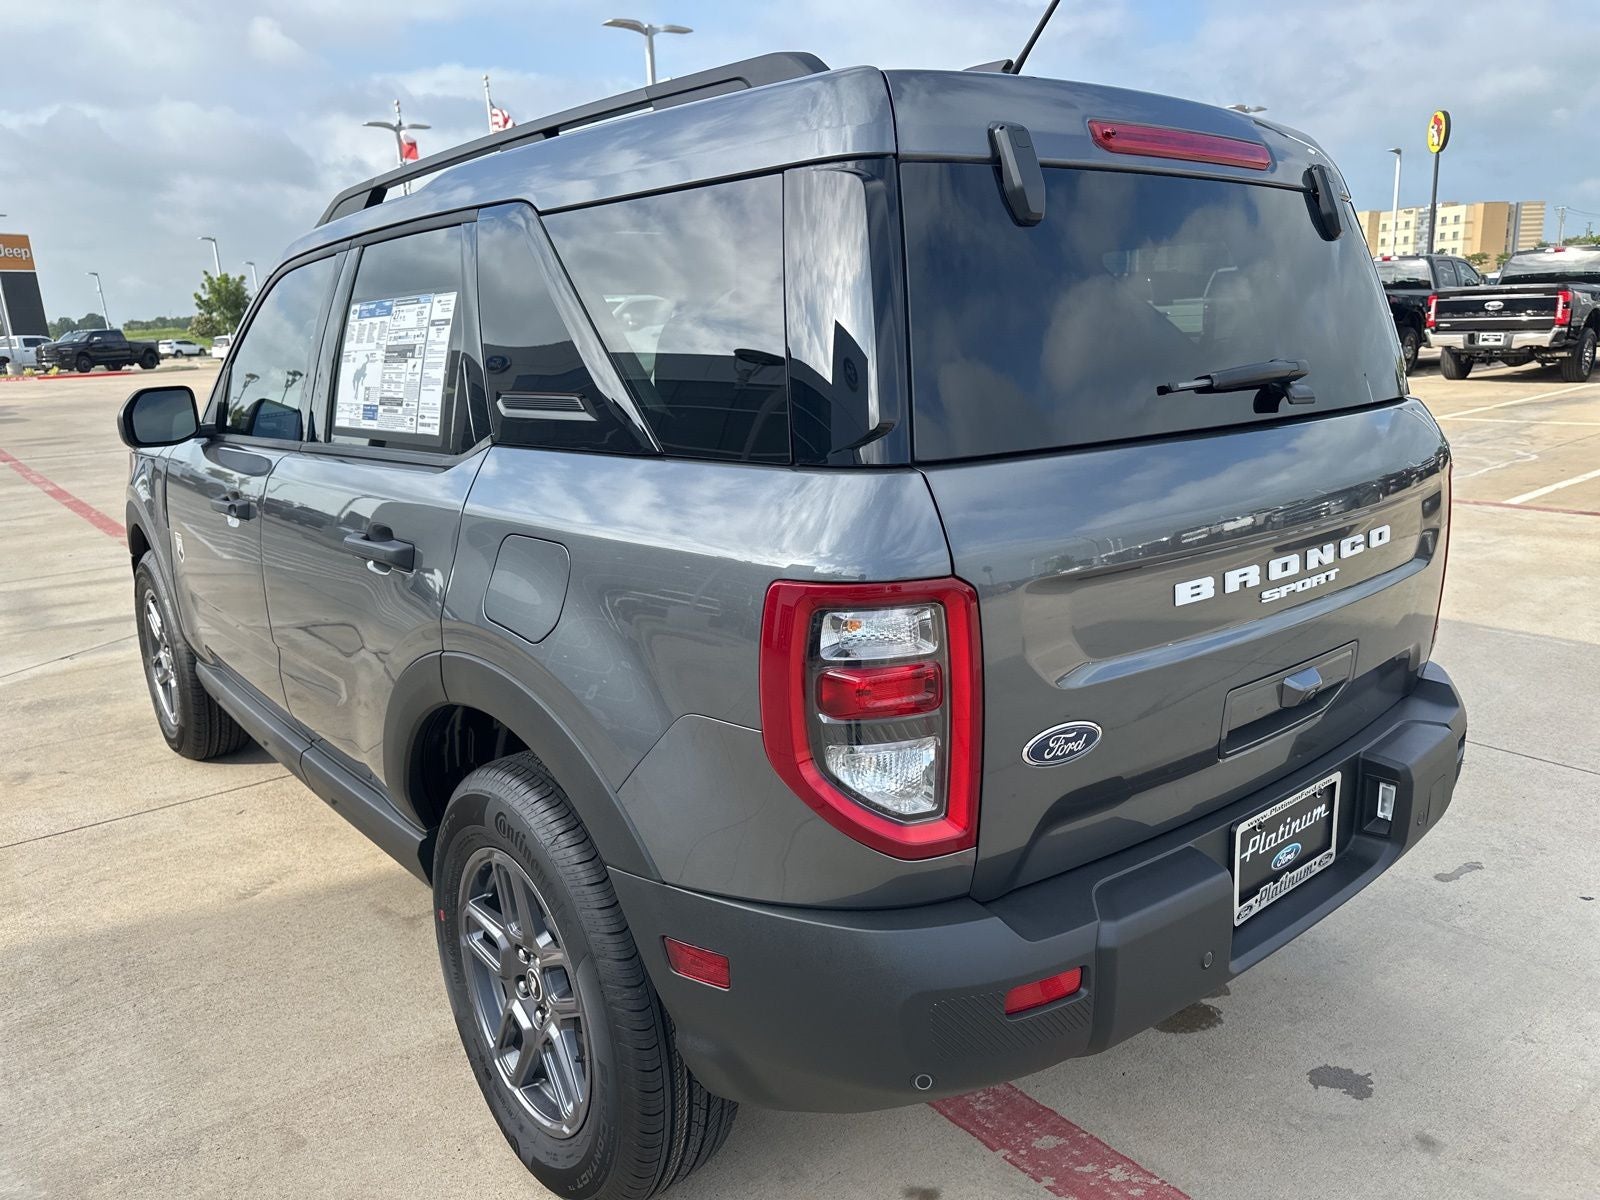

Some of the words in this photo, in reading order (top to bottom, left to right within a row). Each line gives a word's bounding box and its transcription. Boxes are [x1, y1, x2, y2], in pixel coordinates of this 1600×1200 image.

[1174, 525, 1391, 607] BRONCO
[1260, 568, 1340, 604] SPORT
[1044, 731, 1087, 760] Ford
[1241, 803, 1330, 862] Platinum
[1258, 863, 1316, 907] Platinum
